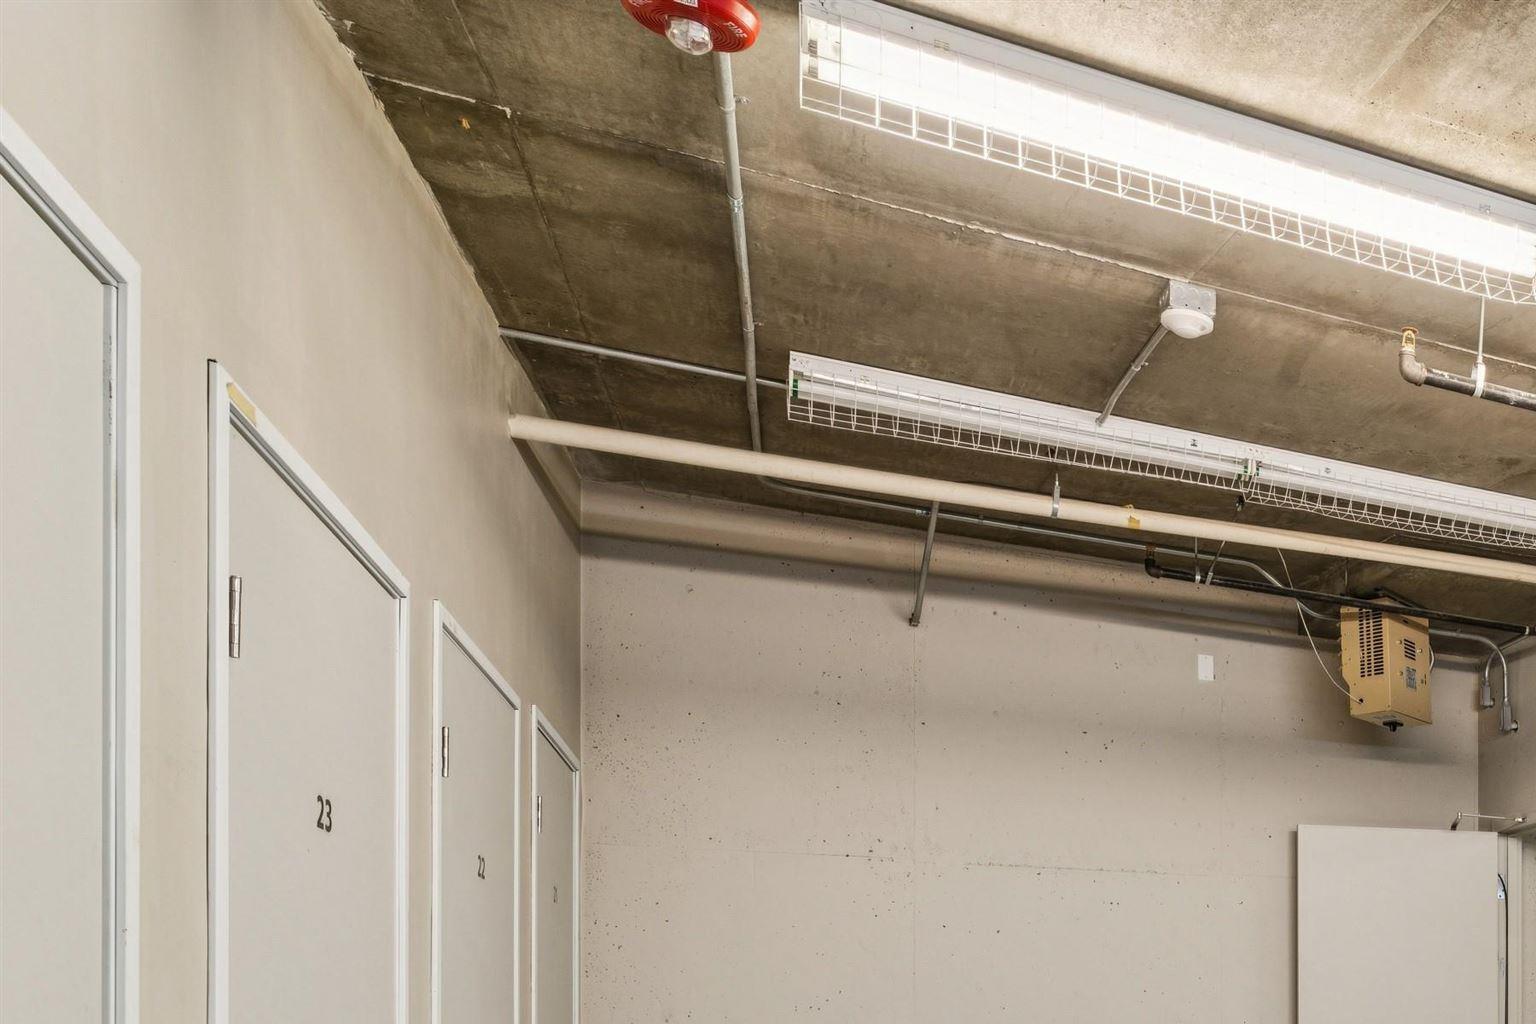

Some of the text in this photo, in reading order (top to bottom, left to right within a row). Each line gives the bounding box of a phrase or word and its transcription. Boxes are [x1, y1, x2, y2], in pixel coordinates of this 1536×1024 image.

[725, 21, 748, 38] FIRE
[316, 794, 332, 833] 23
[477, 854, 486, 880] 22
